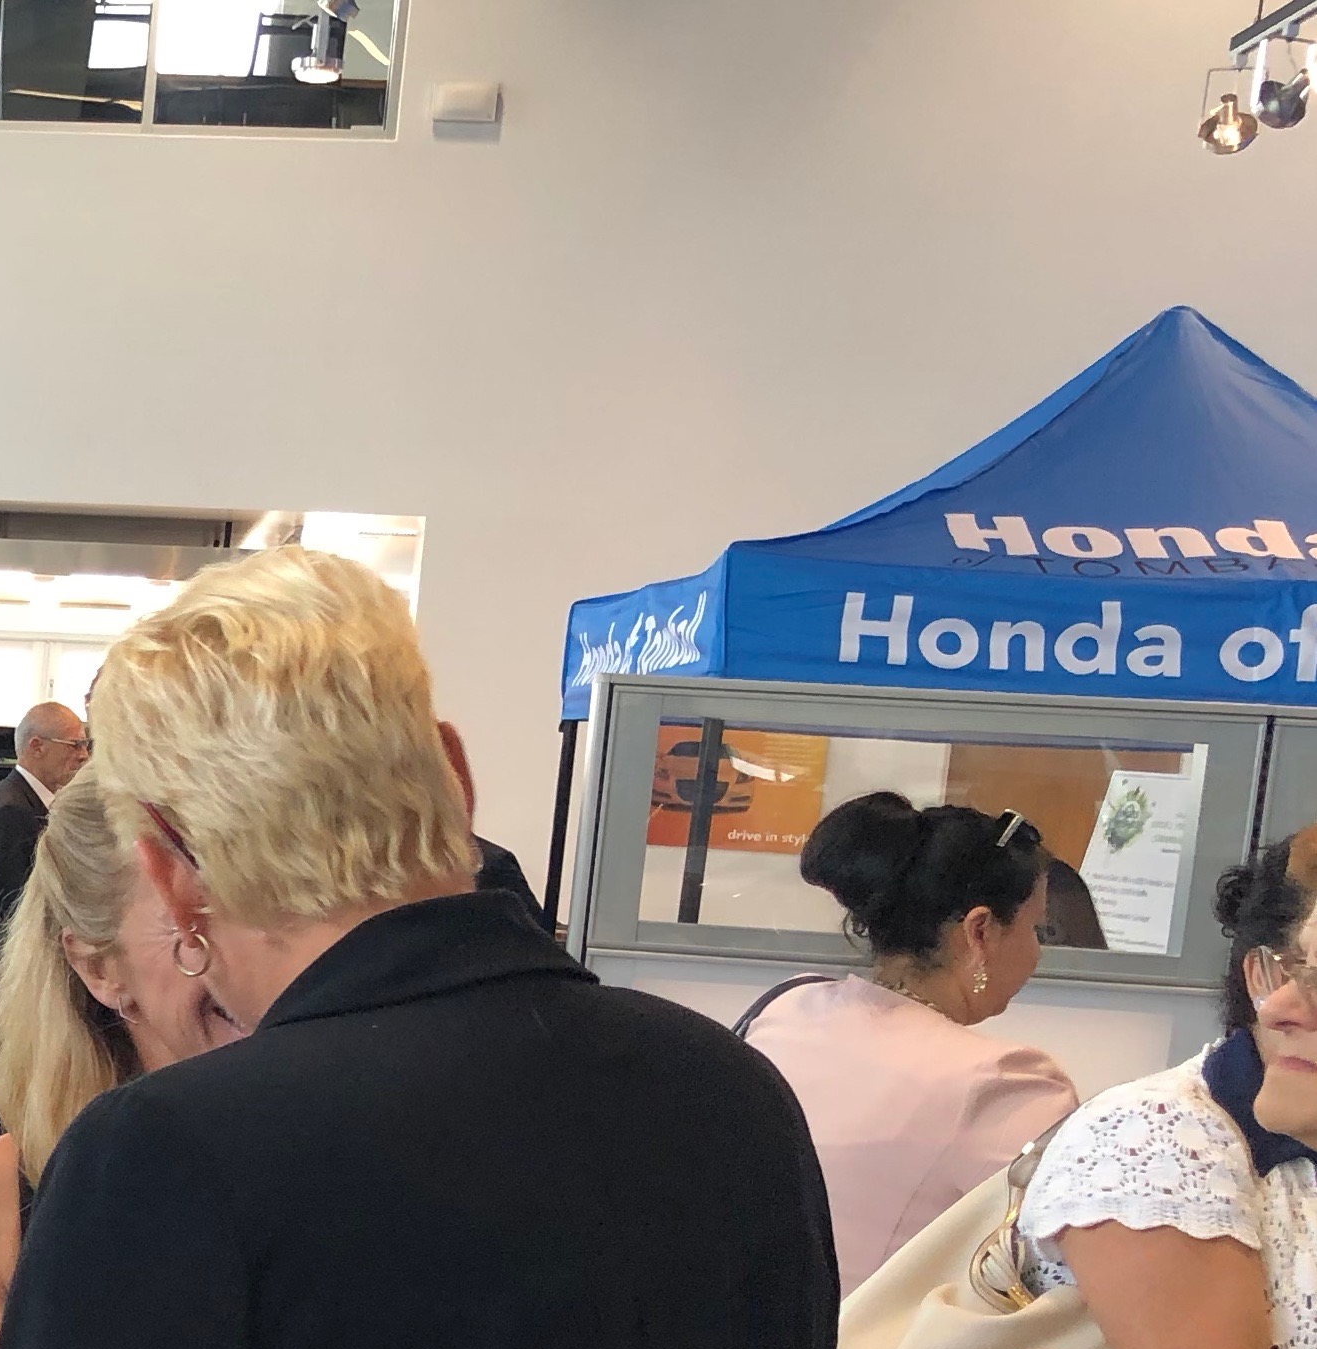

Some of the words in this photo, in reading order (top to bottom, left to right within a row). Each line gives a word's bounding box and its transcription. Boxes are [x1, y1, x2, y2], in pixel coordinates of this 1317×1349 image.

[838, 592, 1182, 678] Honda
[1219, 602, 1317, 682] of
[727, 829, 762, 842] drive
[765, 832, 778, 842] in
